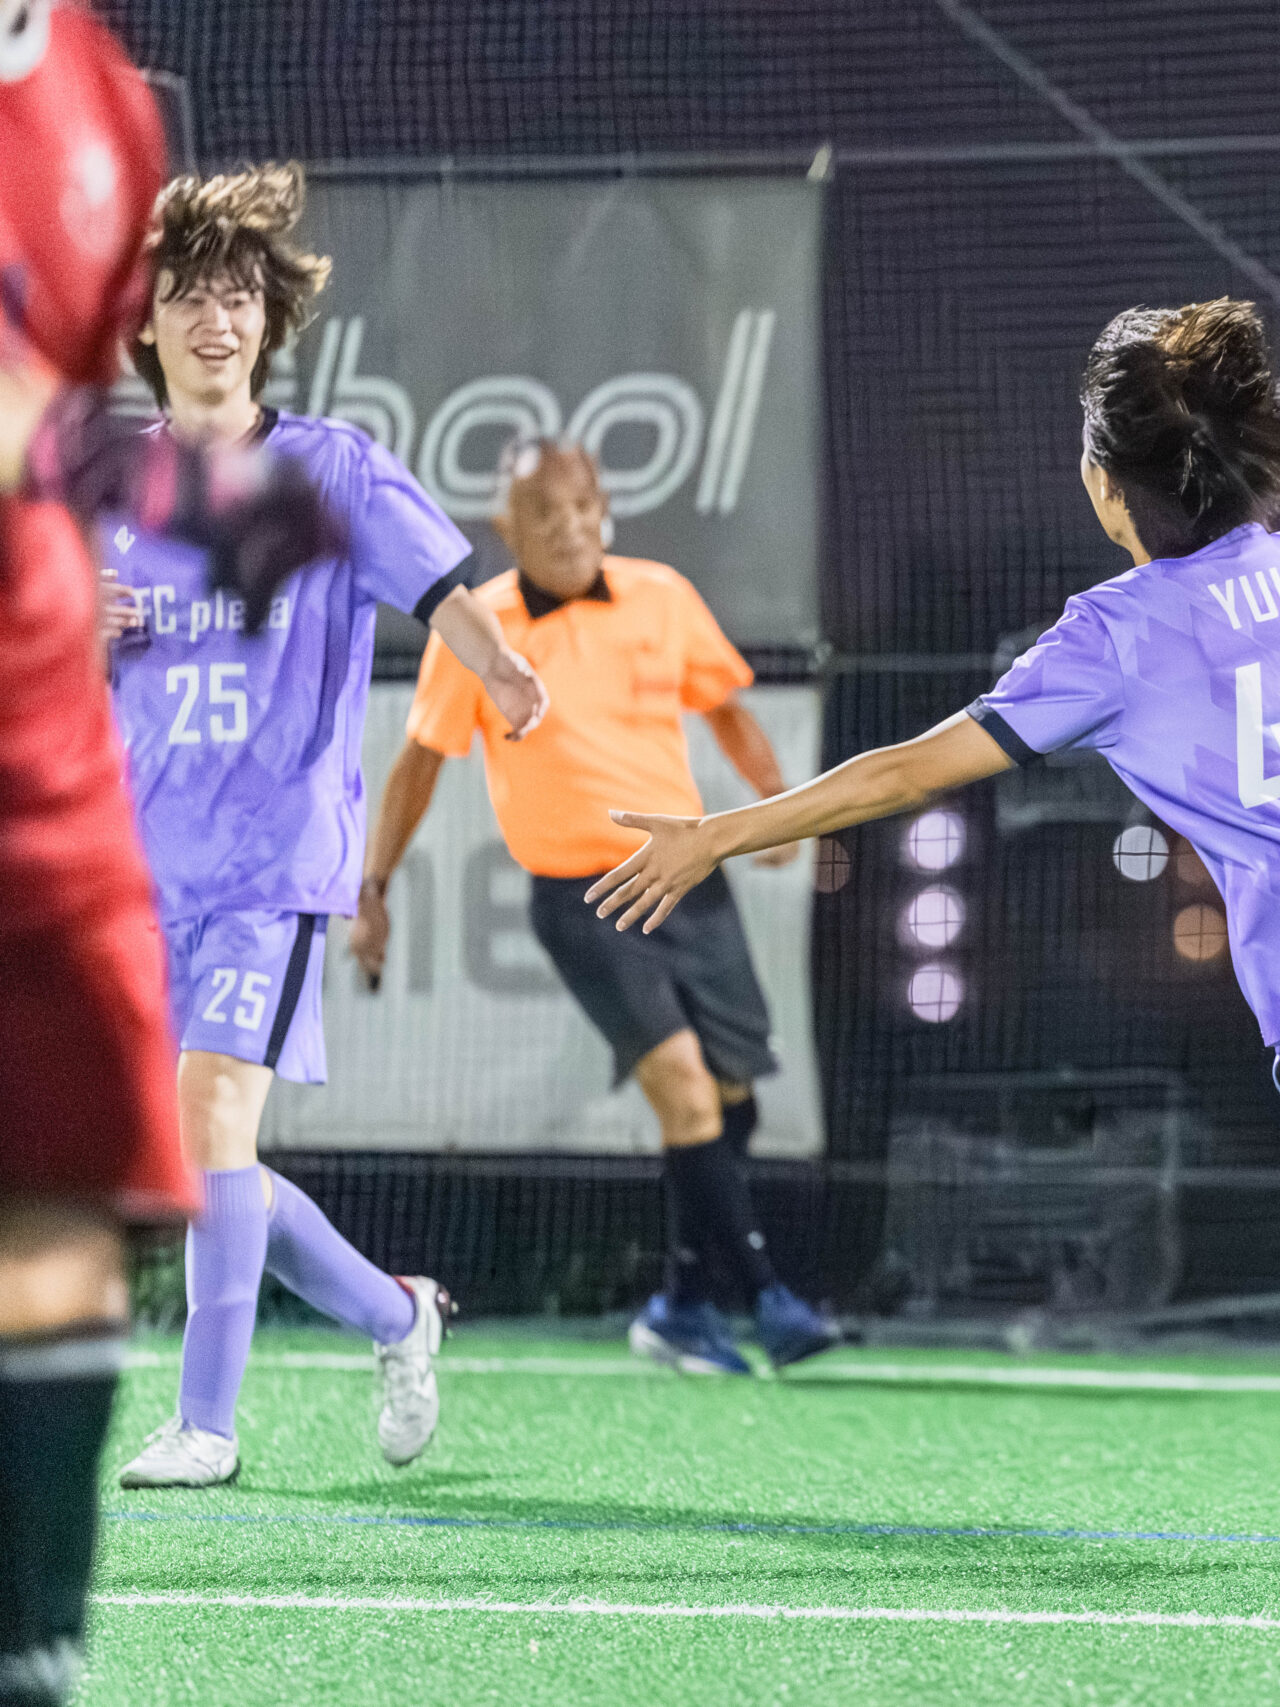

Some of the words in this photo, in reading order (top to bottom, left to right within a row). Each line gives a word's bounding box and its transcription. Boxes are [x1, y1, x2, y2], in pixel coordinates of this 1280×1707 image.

[189, 587, 290, 644] plea
[166, 662, 249, 745] 25
[202, 967, 273, 1032] 25
